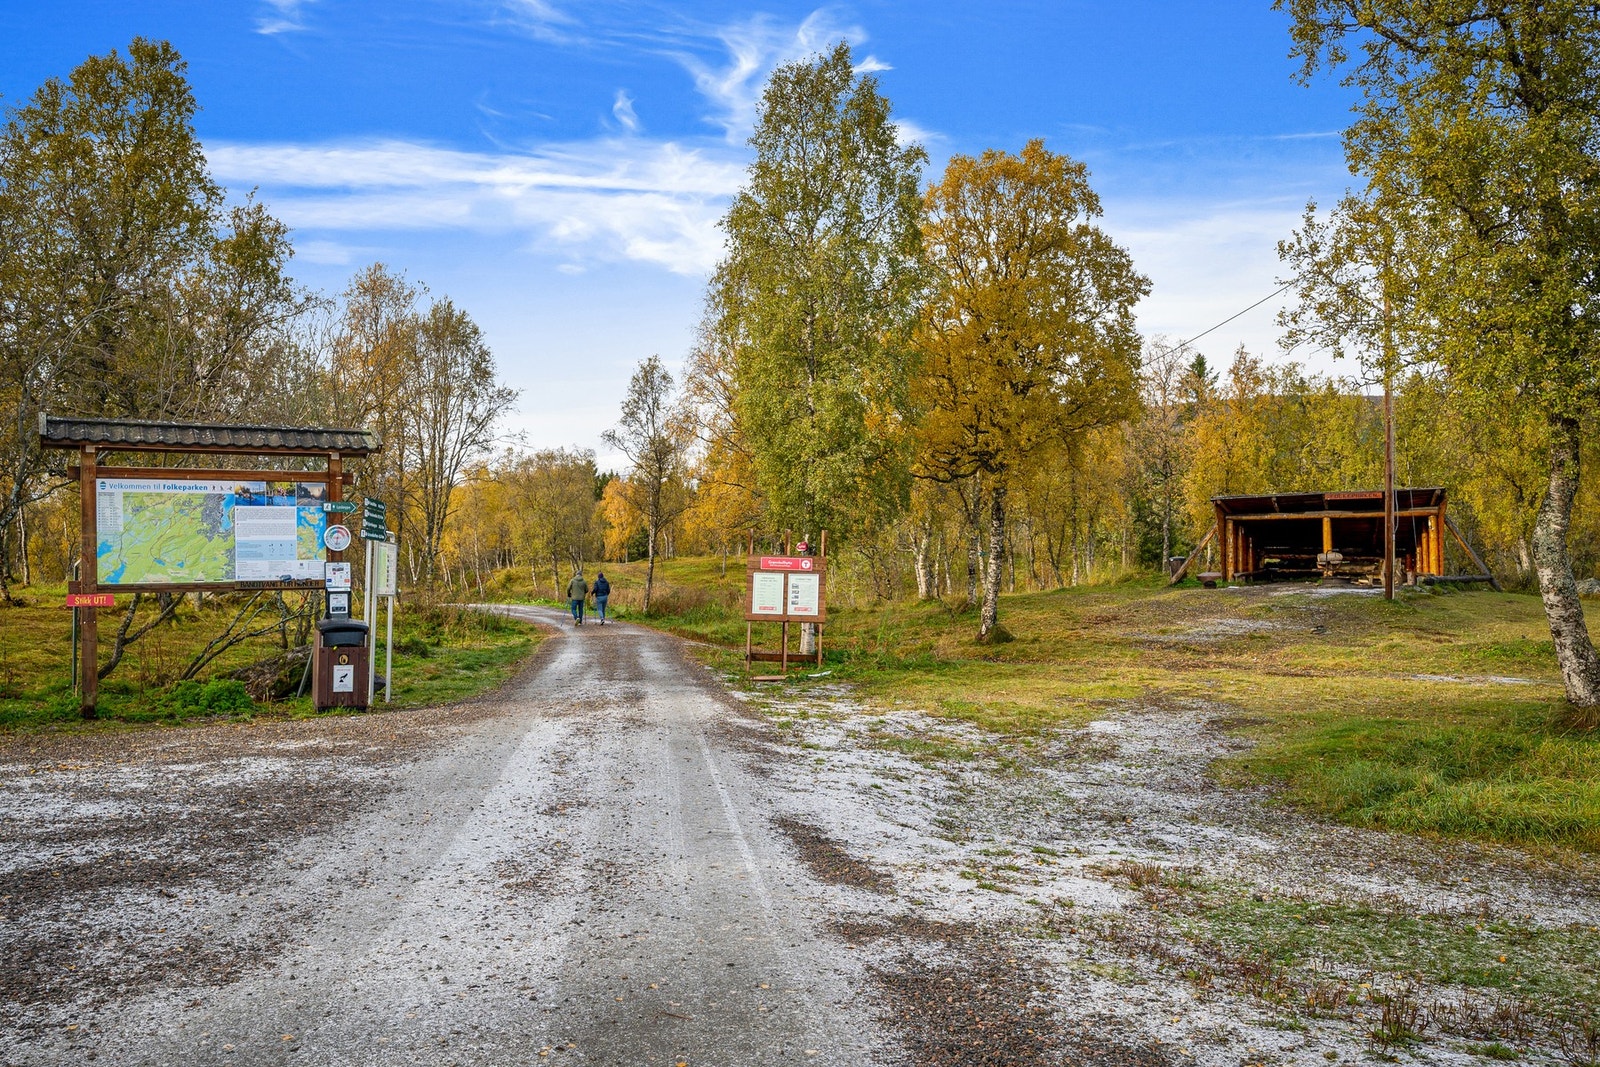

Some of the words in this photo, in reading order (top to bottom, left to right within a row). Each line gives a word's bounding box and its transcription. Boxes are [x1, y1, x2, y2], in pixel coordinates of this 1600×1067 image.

[109, 481, 151, 490] Velkommen
[153, 482, 161, 490] til
[163, 483, 208, 491] Folkeparken
[74, 596, 91, 605] Stikk
[93, 596, 107, 605] UT!
